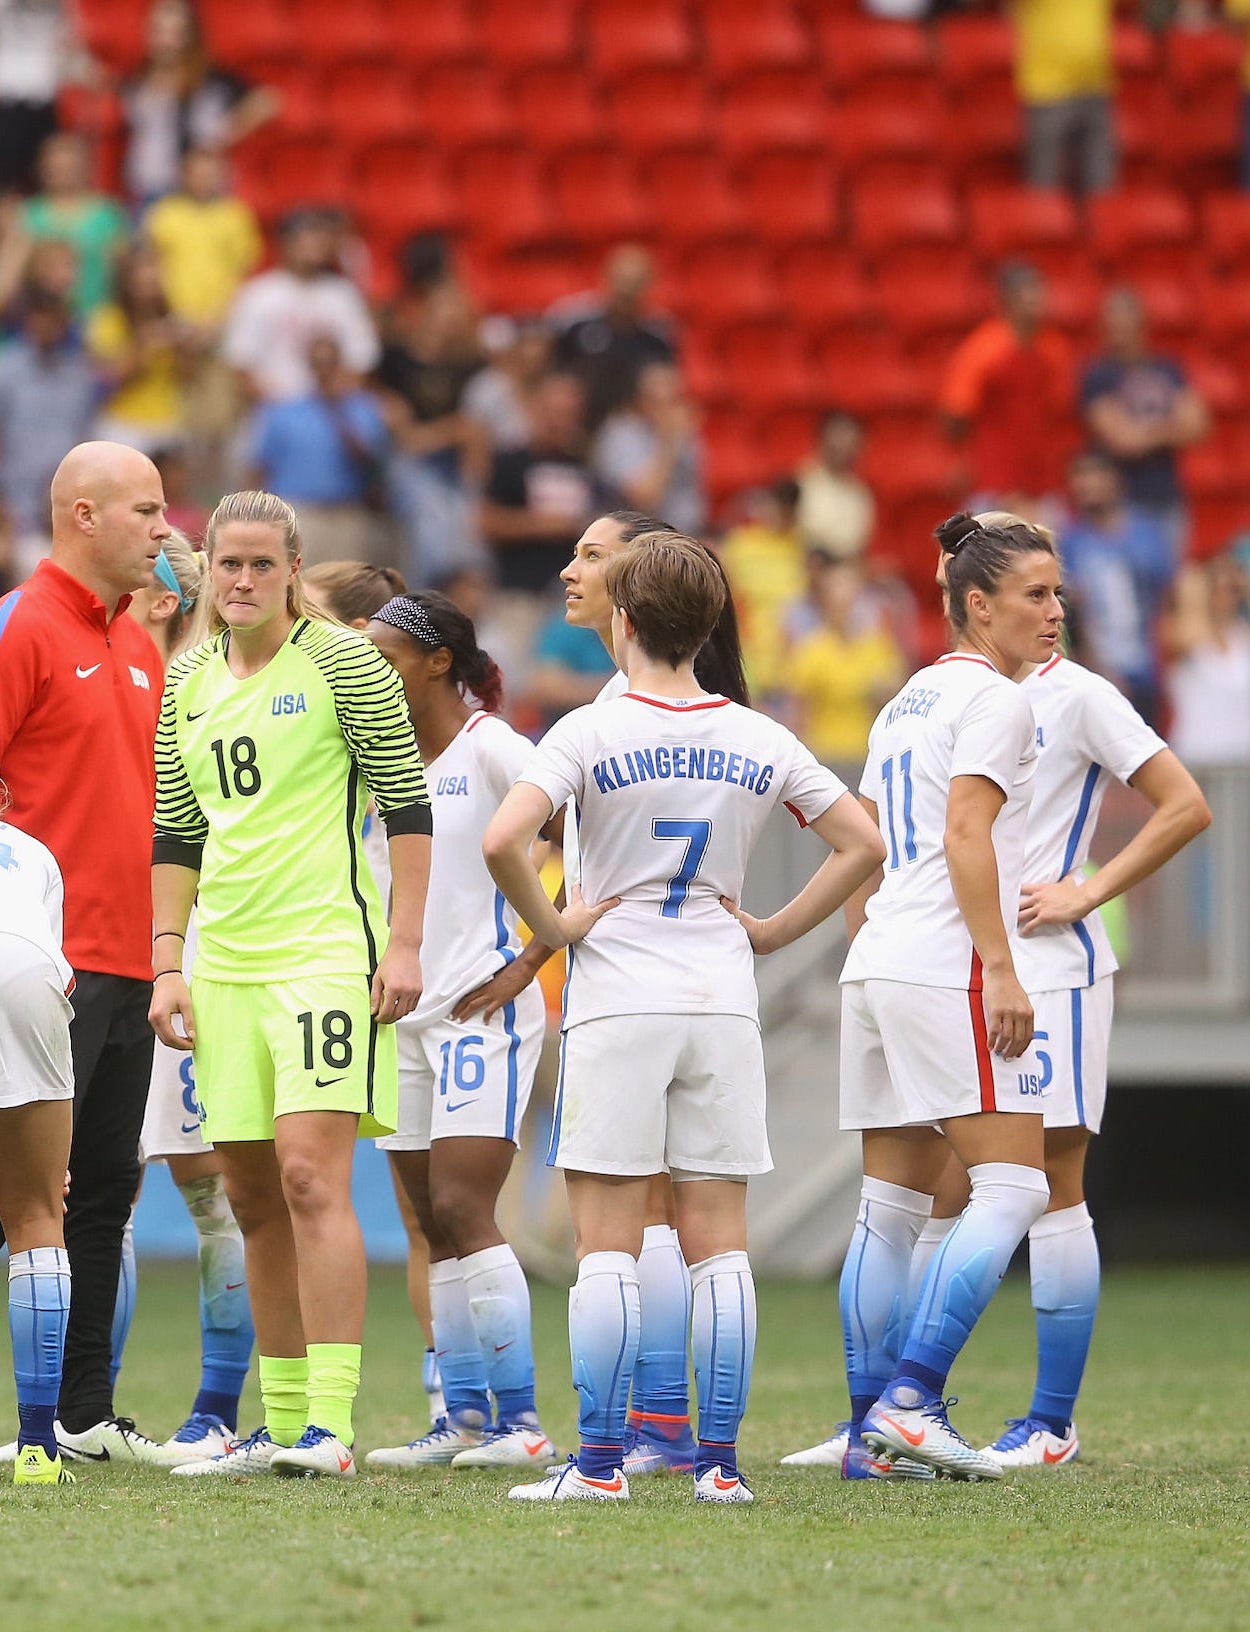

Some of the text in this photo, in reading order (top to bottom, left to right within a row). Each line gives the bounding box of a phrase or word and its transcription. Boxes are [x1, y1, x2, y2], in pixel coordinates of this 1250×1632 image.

[271, 692, 307, 716] USA
[211, 736, 262, 799] 18
[437, 776, 469, 796] USA
[593, 746, 774, 795] KLINGENBERG
[881, 747, 918, 872] 11
[651, 818, 713, 919] 7
[297, 1010, 352, 1070] 18
[440, 1035, 485, 1096] 16
